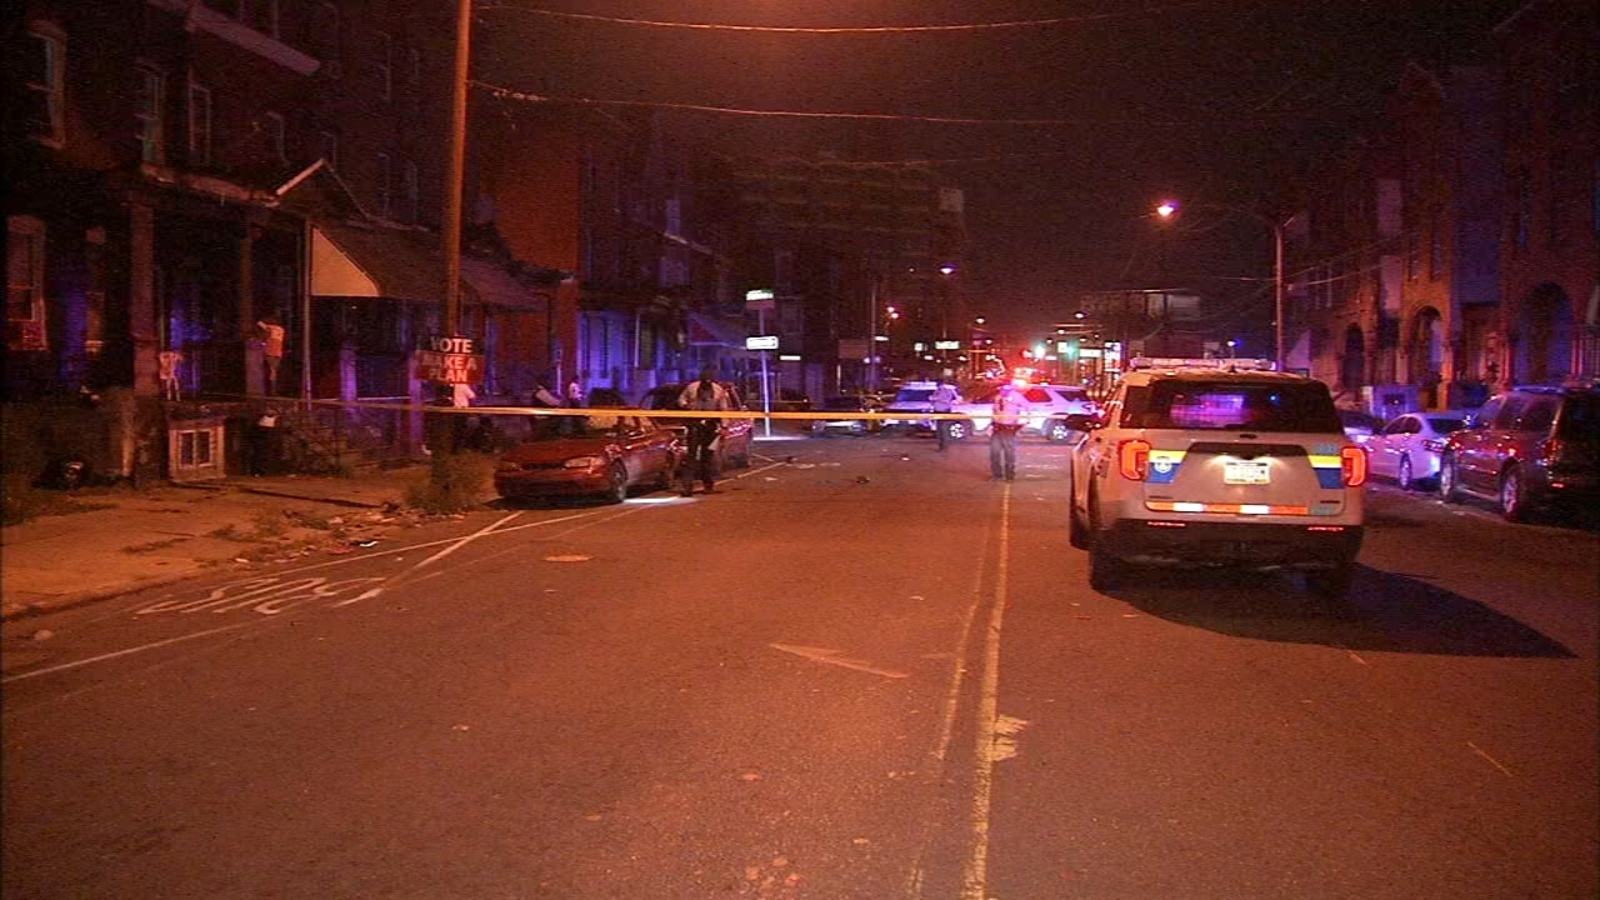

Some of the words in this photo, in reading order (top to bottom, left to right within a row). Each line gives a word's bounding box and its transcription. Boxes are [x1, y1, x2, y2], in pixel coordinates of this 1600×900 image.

[430, 336, 473, 353] VOTE
[466, 357, 478, 370] A
[429, 368, 468, 382] PLAN
